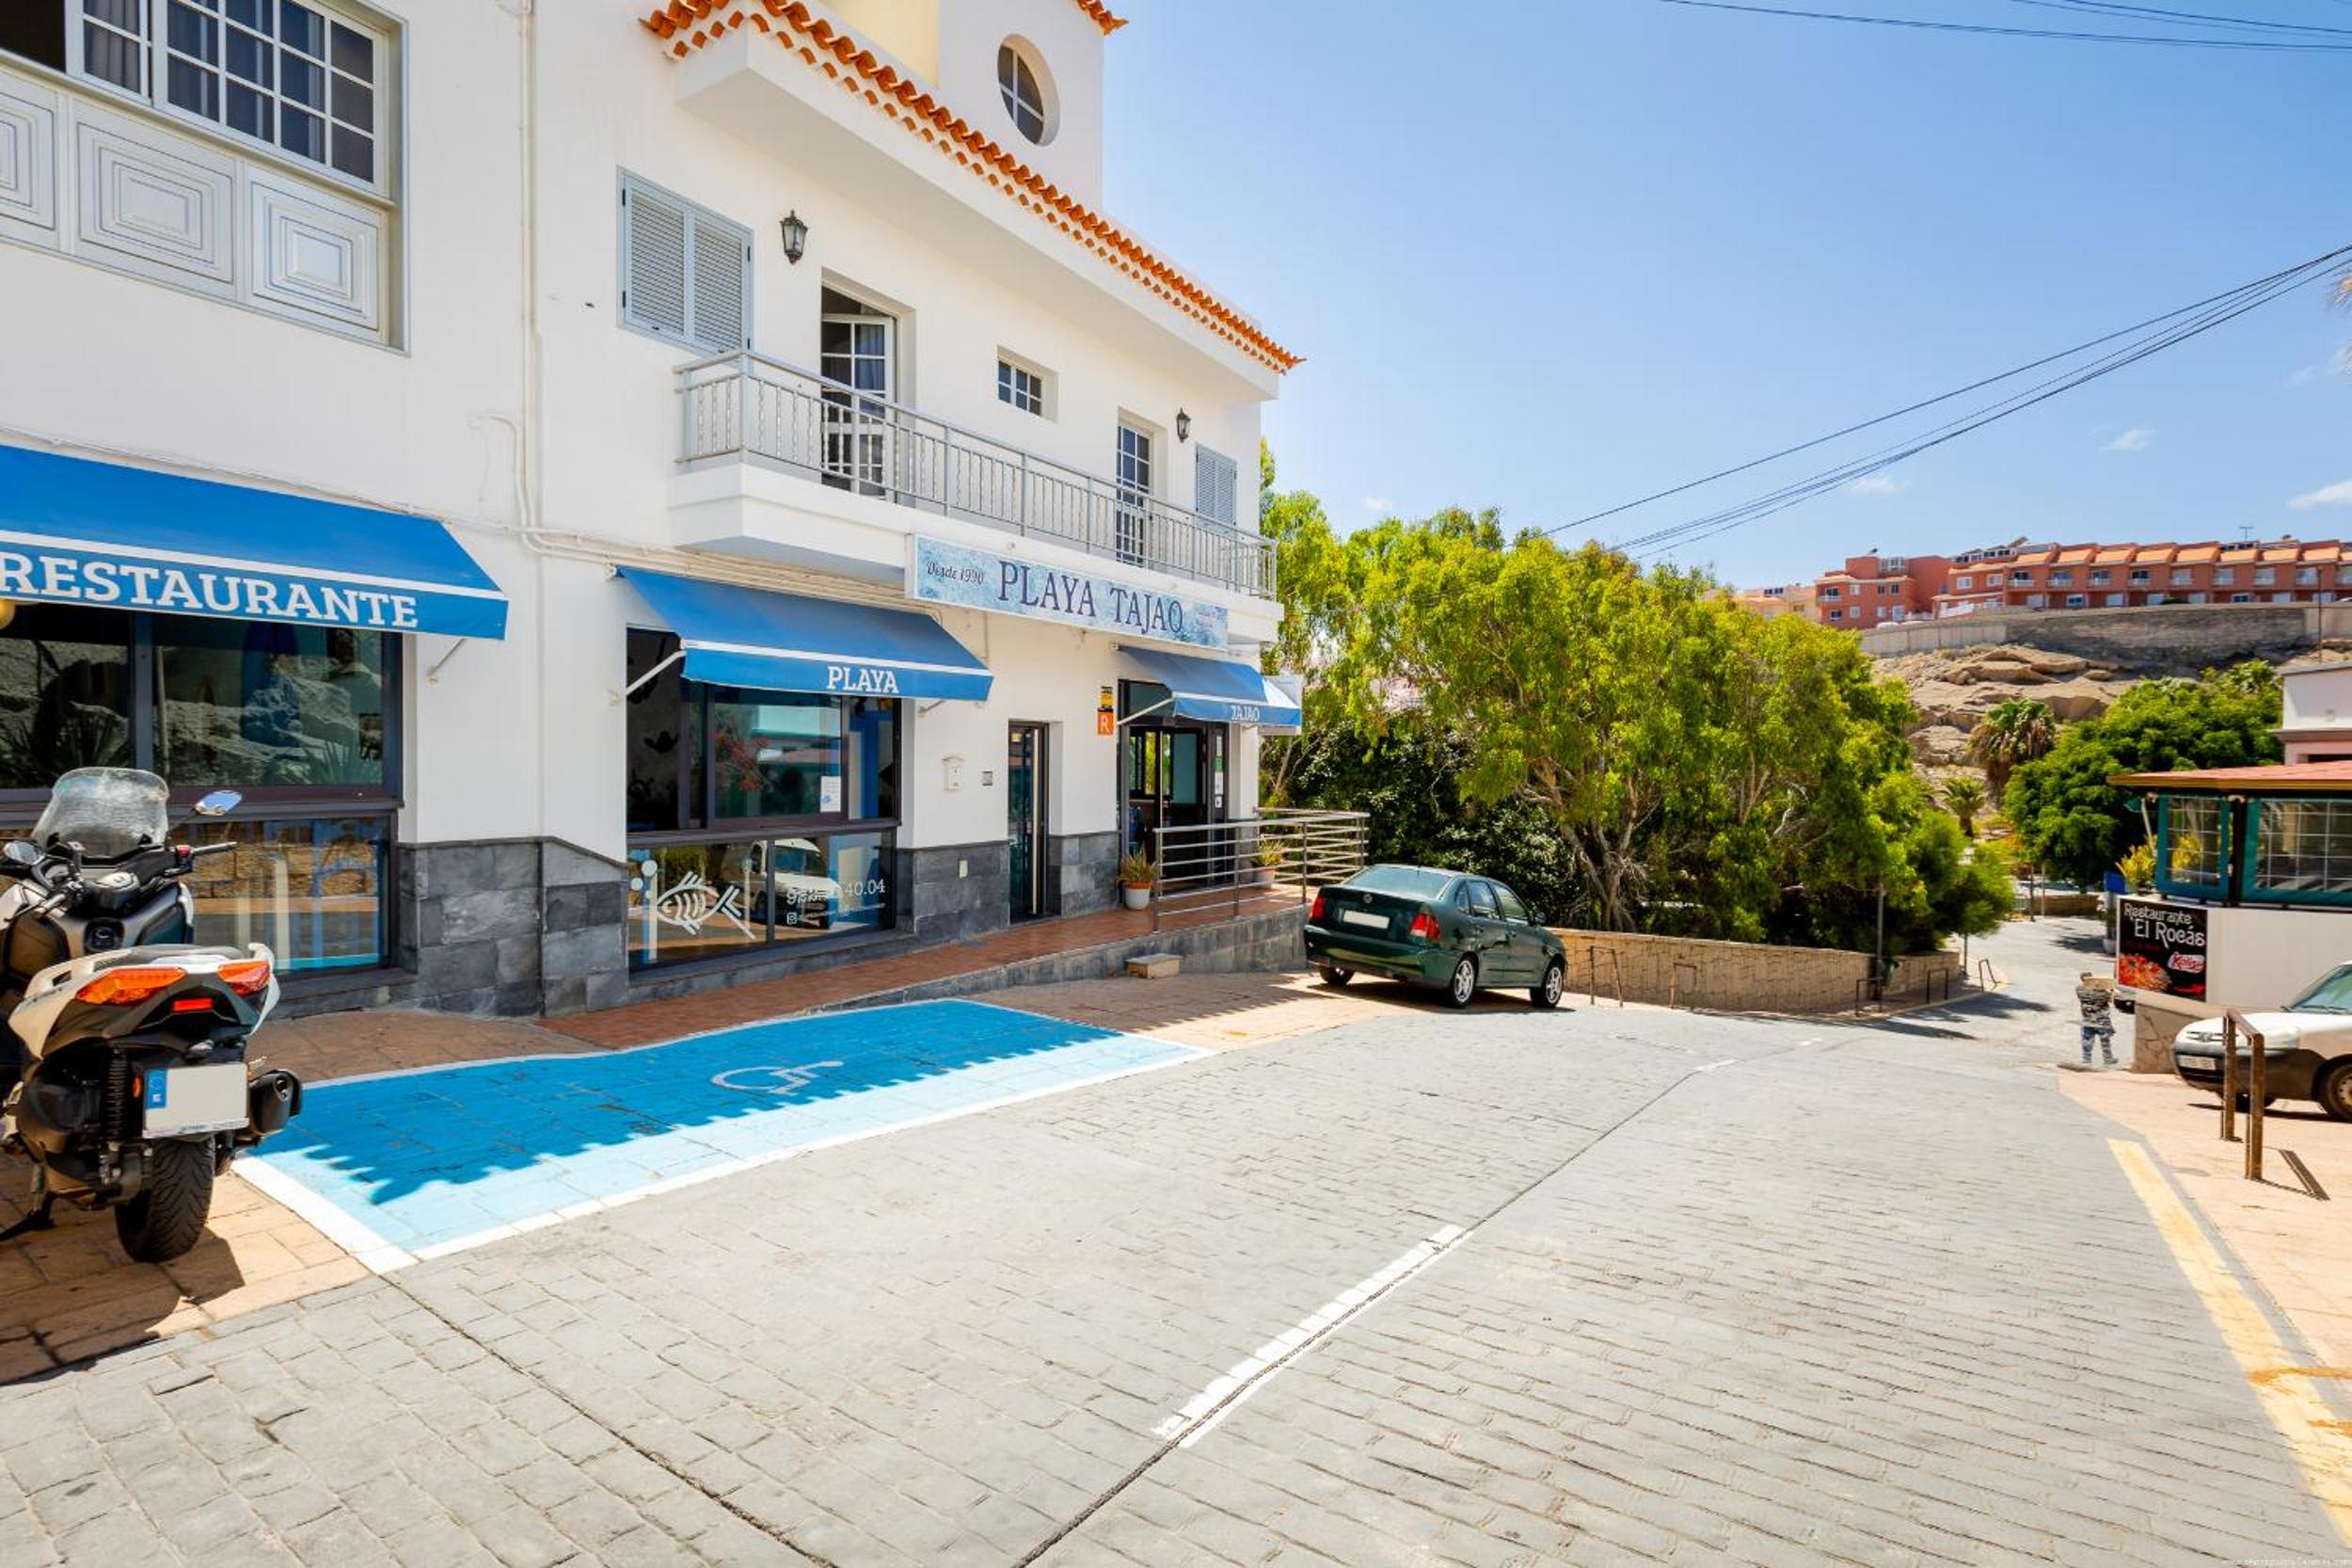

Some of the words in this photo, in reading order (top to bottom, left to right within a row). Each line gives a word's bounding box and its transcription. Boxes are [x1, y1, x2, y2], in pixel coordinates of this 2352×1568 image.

[927, 561, 957, 580] Desde
[0, 551, 419, 629] RESTAURANTE
[997, 560, 1097, 618] PLAYA
[1109, 587, 1185, 635] TAJAO
[827, 664, 899, 695] PLAYA
[1100, 714, 1110, 734] R
[1231, 705, 1261, 721] TAJAO
[2123, 902, 2192, 926] Restaurante
[2134, 918, 2150, 939] El
